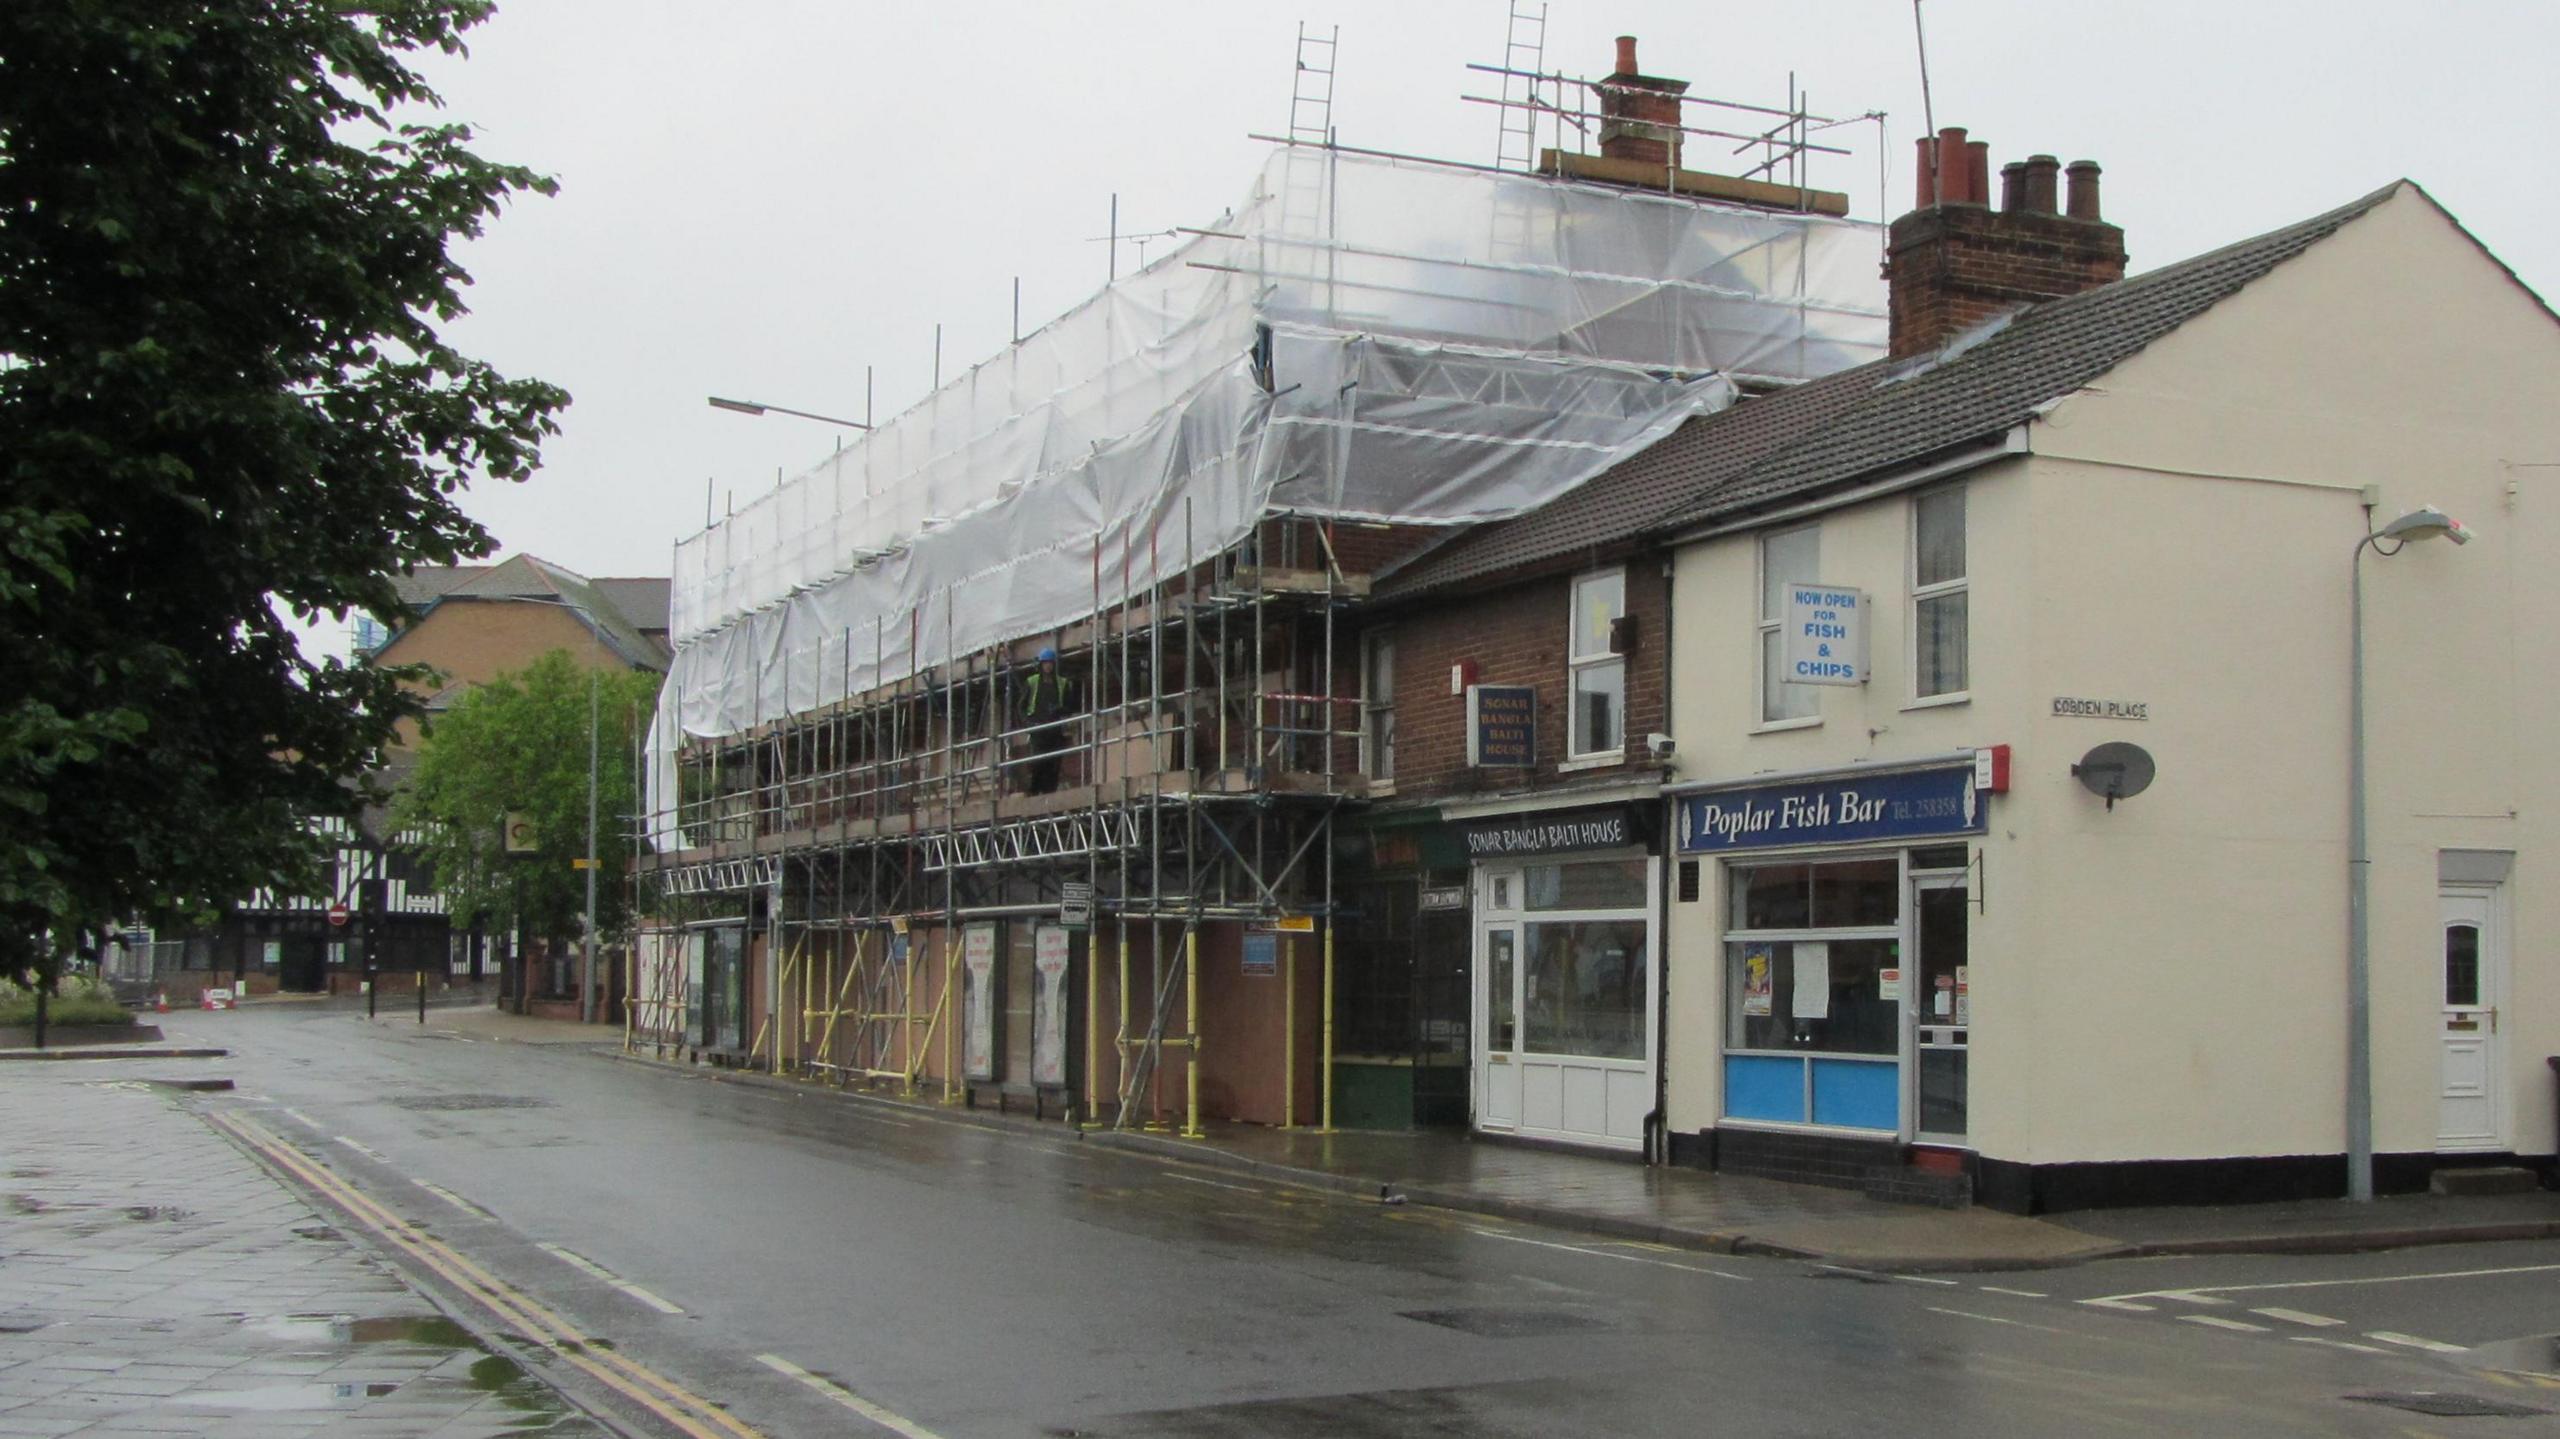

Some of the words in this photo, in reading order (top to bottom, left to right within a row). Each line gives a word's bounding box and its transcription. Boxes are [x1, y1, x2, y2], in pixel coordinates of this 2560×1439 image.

[1795, 591, 1822, 605] NOW
[1825, 593, 1856, 608] OPEN
[1813, 610, 1836, 620] FOR
[1804, 623, 1846, 639] FISH
[1818, 643, 1830, 657] &
[1796, 661, 1854, 678] CHIPS
[1485, 698, 1528, 710] SONAR
[2054, 700, 2102, 715] COBDEN
[2108, 702, 2147, 718] PLACE
[1480, 713, 1532, 725] BANGLA
[1489, 729, 1525, 740] BALTI
[1486, 743, 1526, 755] HOUSE
[1701, 800, 1775, 843] Poplar
[1779, 793, 1831, 829] Fish
[1837, 791, 1887, 825] Bar
[1468, 831, 1504, 853] SONAR
[1503, 826, 1547, 851] BANGLA
[1549, 824, 1579, 848] BALTI
[1582, 819, 1623, 843] HOUSE
